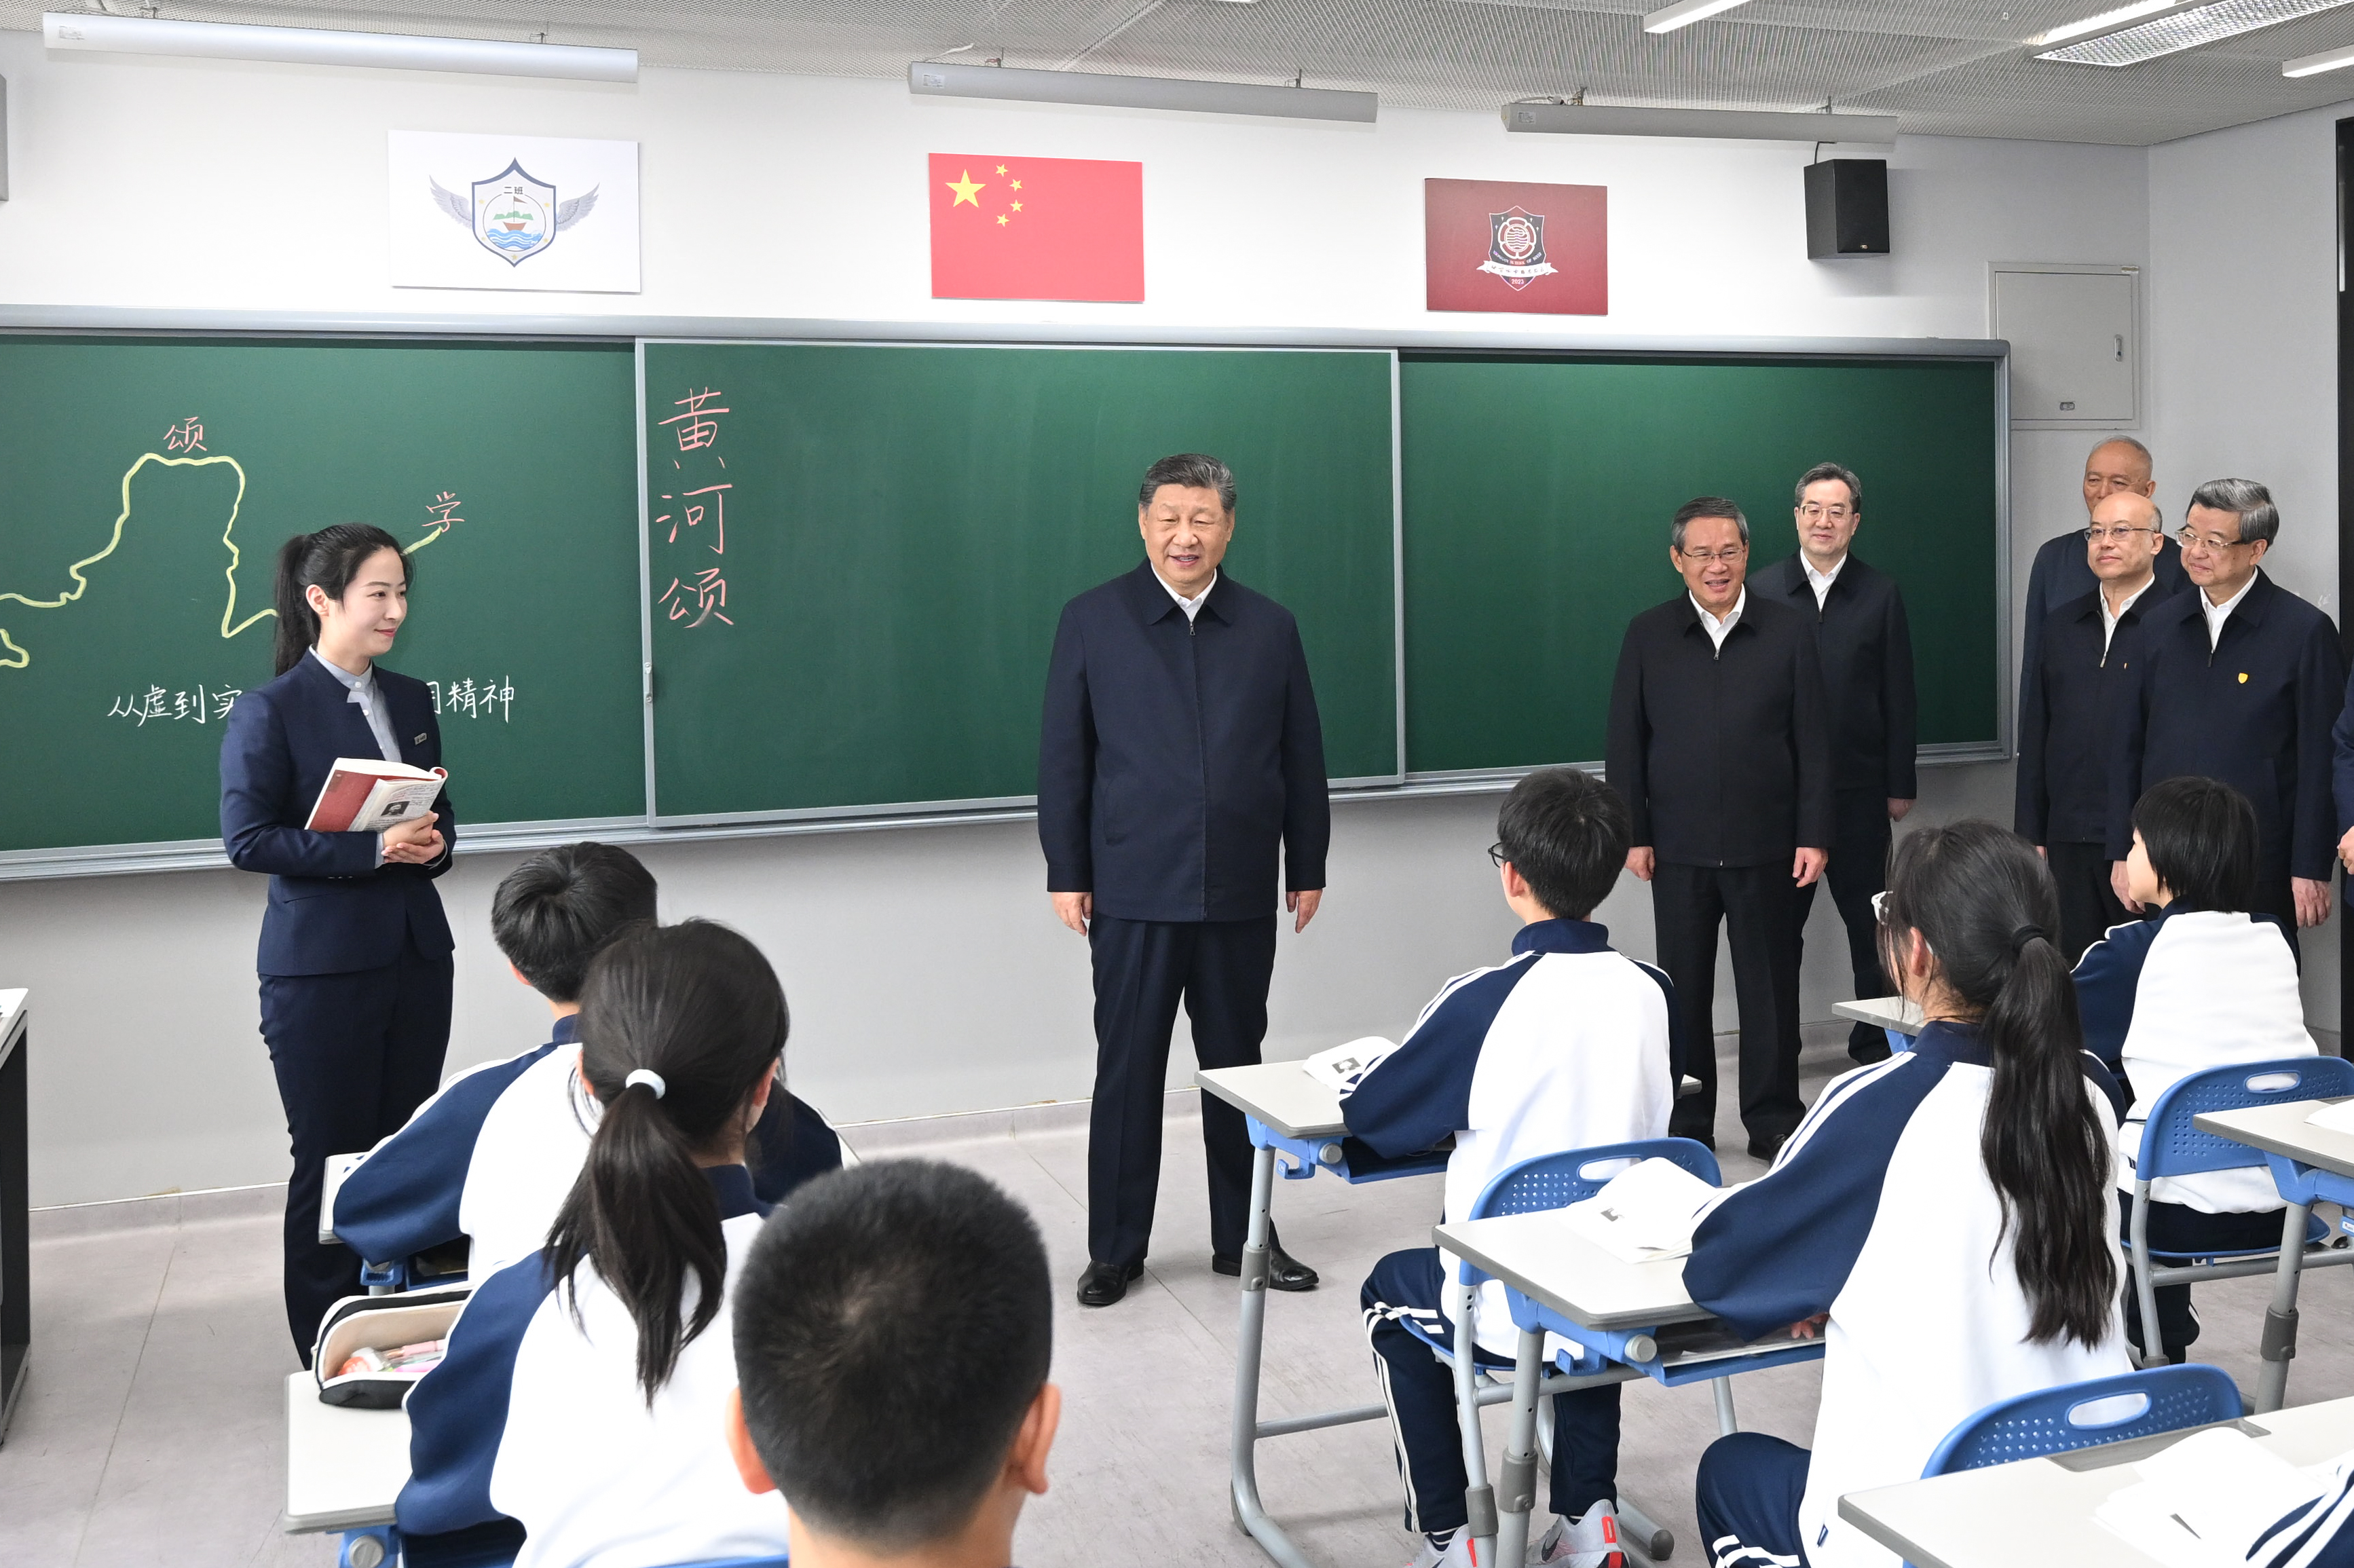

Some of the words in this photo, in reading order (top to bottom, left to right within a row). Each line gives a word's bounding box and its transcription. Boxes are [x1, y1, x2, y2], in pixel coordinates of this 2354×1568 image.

[504, 186, 523, 195] 二班
[163, 416, 208, 453] 颂
[421, 491, 465, 533] 学
[656, 387, 734, 629] 黄河颂
